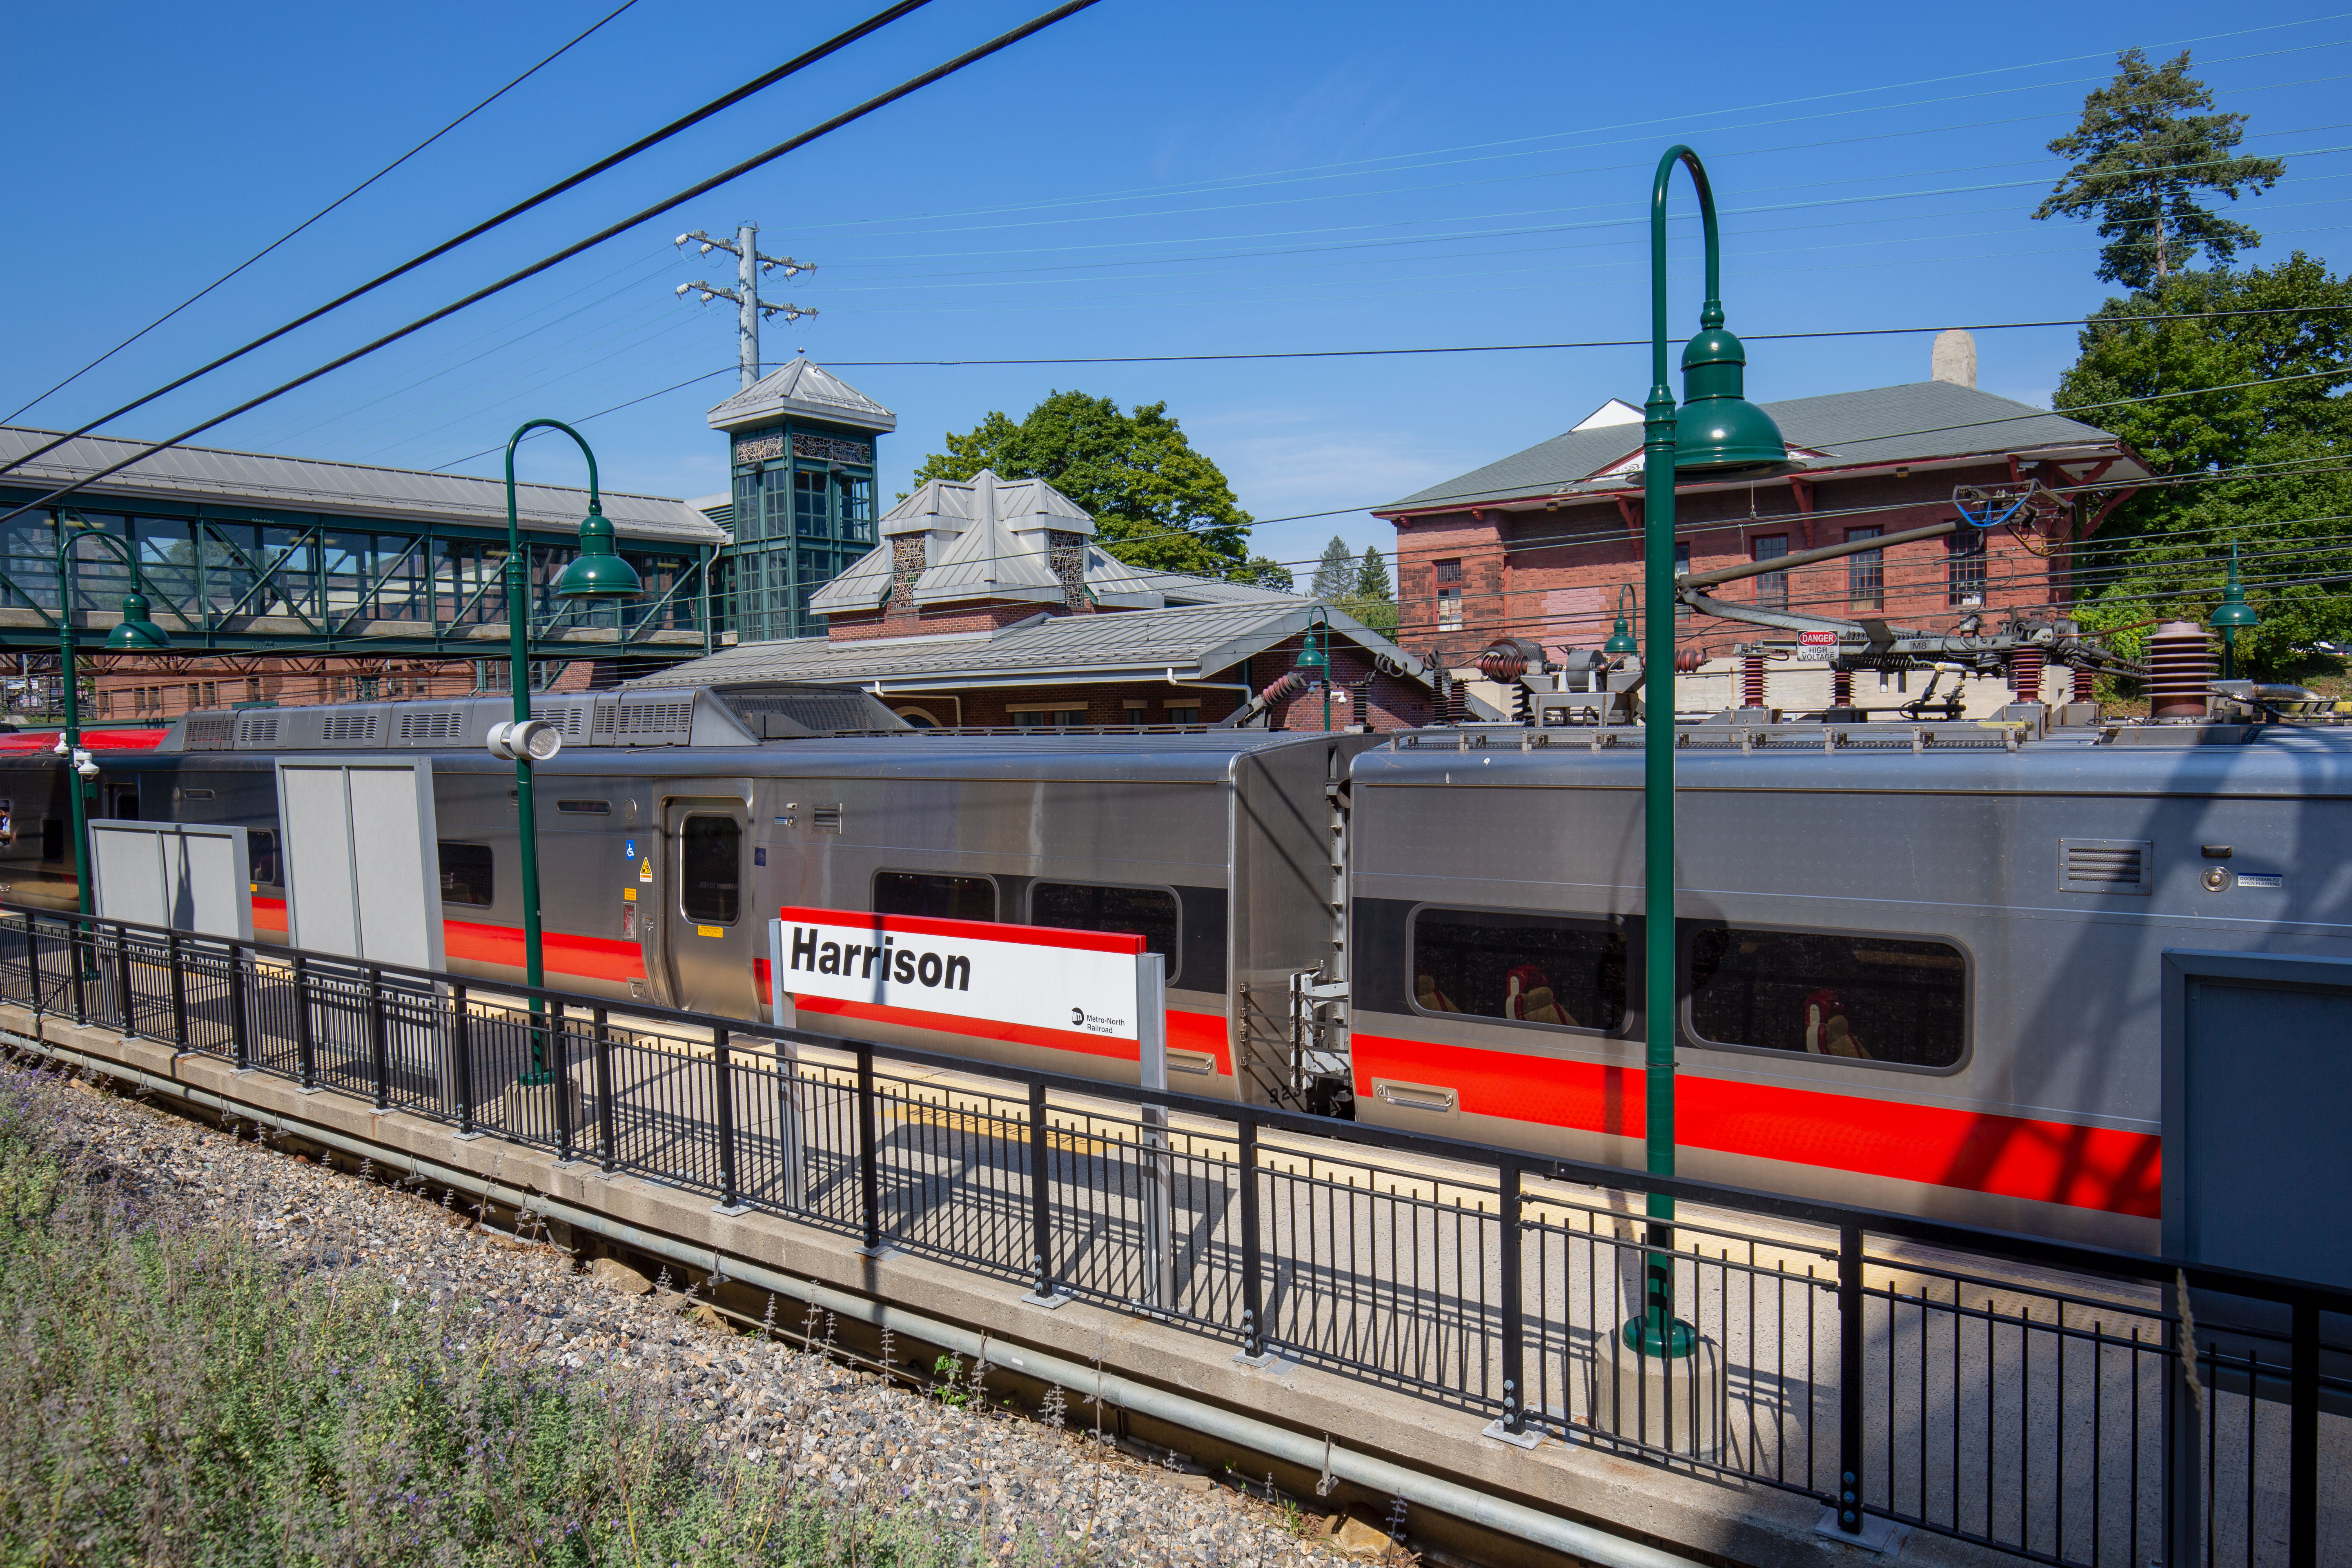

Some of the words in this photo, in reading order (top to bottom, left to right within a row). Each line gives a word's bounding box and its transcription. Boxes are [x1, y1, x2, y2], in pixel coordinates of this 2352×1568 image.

[1802, 634, 1834, 642] DANGER
[791, 927, 971, 991] Harrison
[1071, 1010, 1083, 1022] MTA
[1087, 1015, 1125, 1026] Metro-North
[1087, 1024, 1113, 1033] Railroad
[1270, 1084, 1306, 1104] 923
